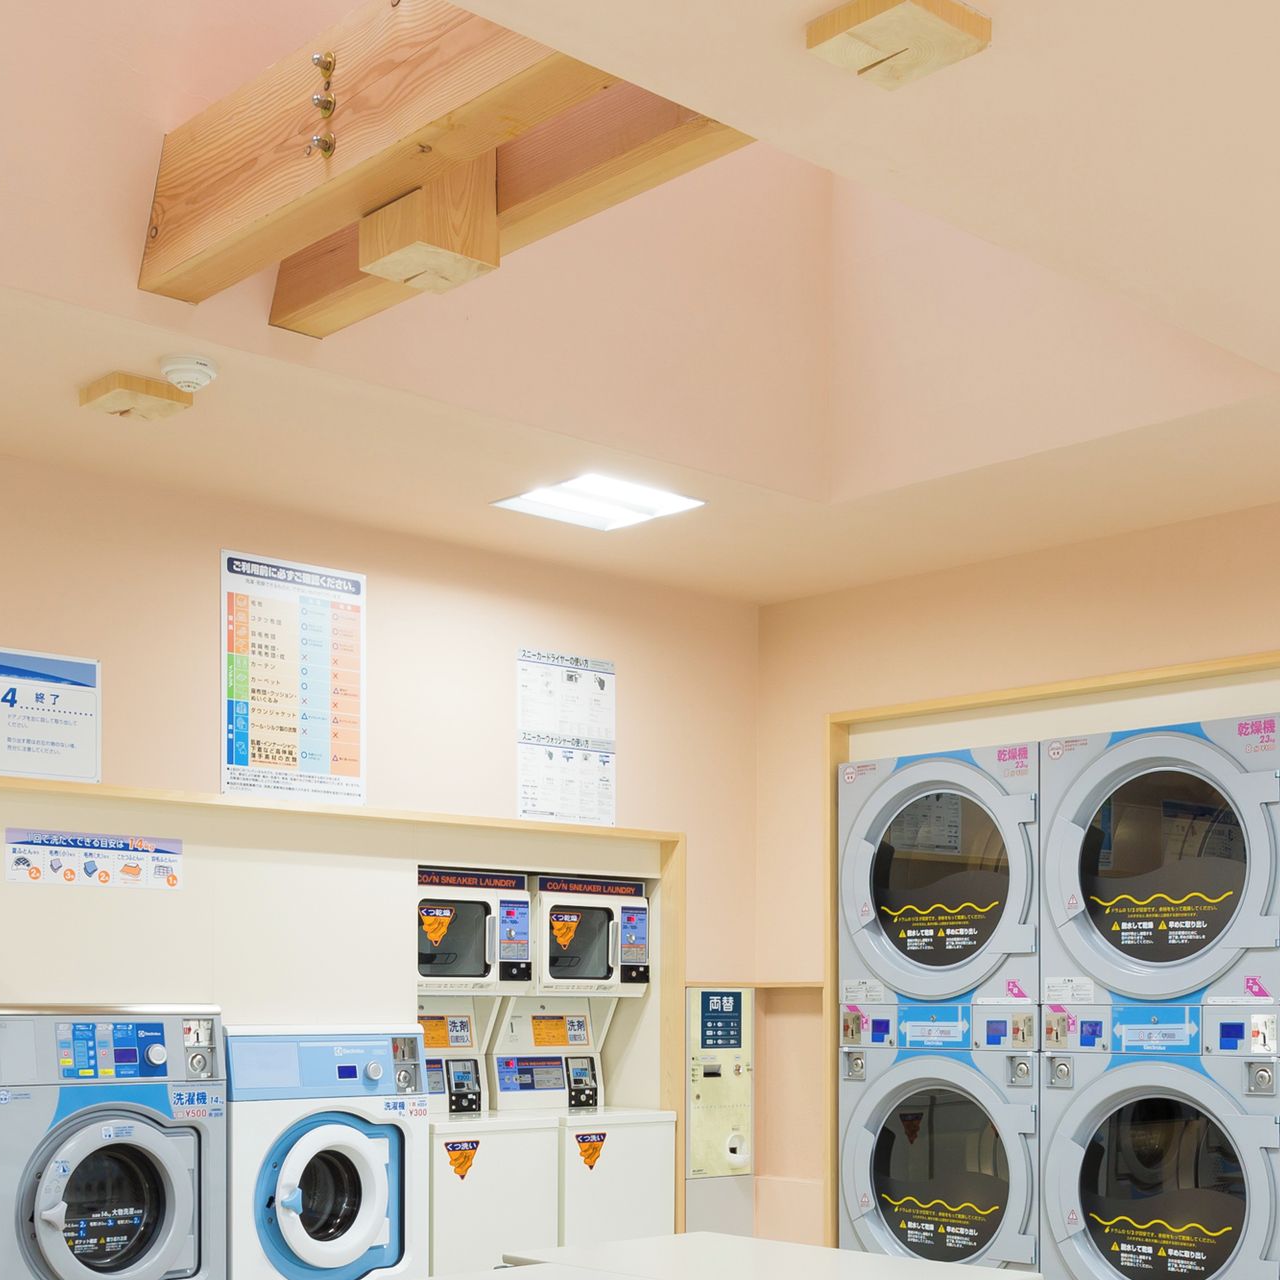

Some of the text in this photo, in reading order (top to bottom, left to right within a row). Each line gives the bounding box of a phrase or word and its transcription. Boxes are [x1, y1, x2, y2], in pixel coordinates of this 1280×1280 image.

[0, 687, 60, 708] 4 終了
[1238, 719, 1276, 737] 乾燥機
[441, 876, 478, 886] SNEAKER
[480, 878, 517, 888] LAUNDRY
[569, 884, 601, 892] SNEAKER
[603, 886, 636, 895] LAUNDRY
[709, 996, 735, 1012] 両替
[449, 1020, 470, 1033] 洗剤
[568, 1020, 585, 1032] 洗剤
[173, 1091, 207, 1106] 洗濯機
[186, 1109, 207, 1118] ¥500
[409, 1108, 428, 1117] ¥300
[577, 1134, 605, 1143] くつ洗い
[447, 1141, 477, 1151] くつ洗い
